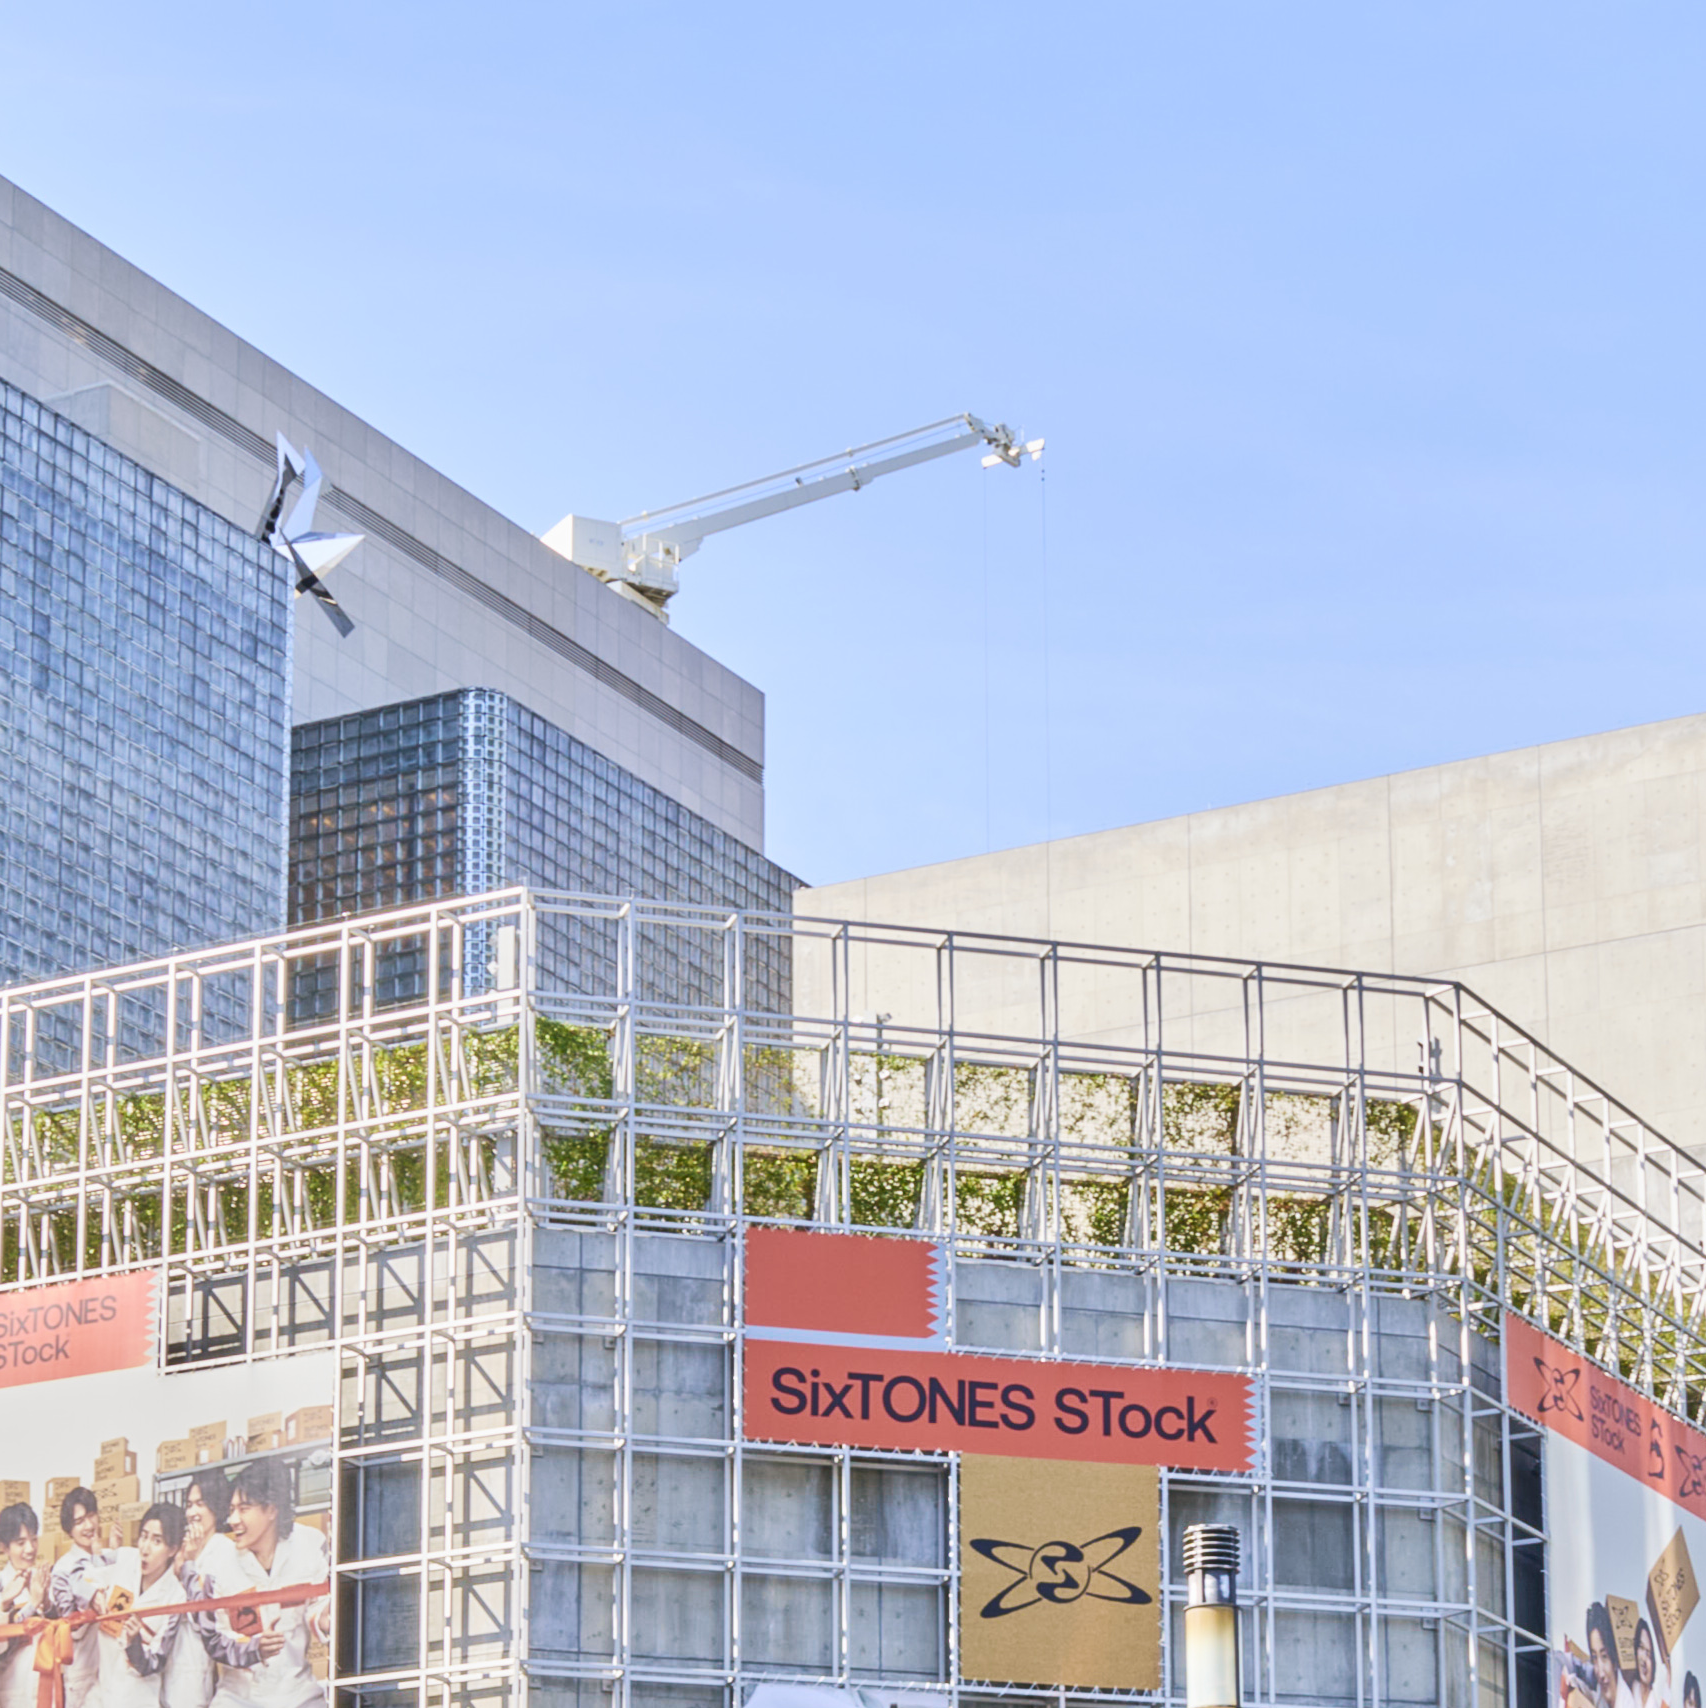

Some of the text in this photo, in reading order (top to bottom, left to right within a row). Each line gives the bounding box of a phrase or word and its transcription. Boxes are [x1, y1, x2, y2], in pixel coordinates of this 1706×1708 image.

[770, 1366, 1218, 1444] SixTONES STock
[1590, 1385, 1642, 1437] SixTONES
[1591, 1413, 1626, 1455] STock
